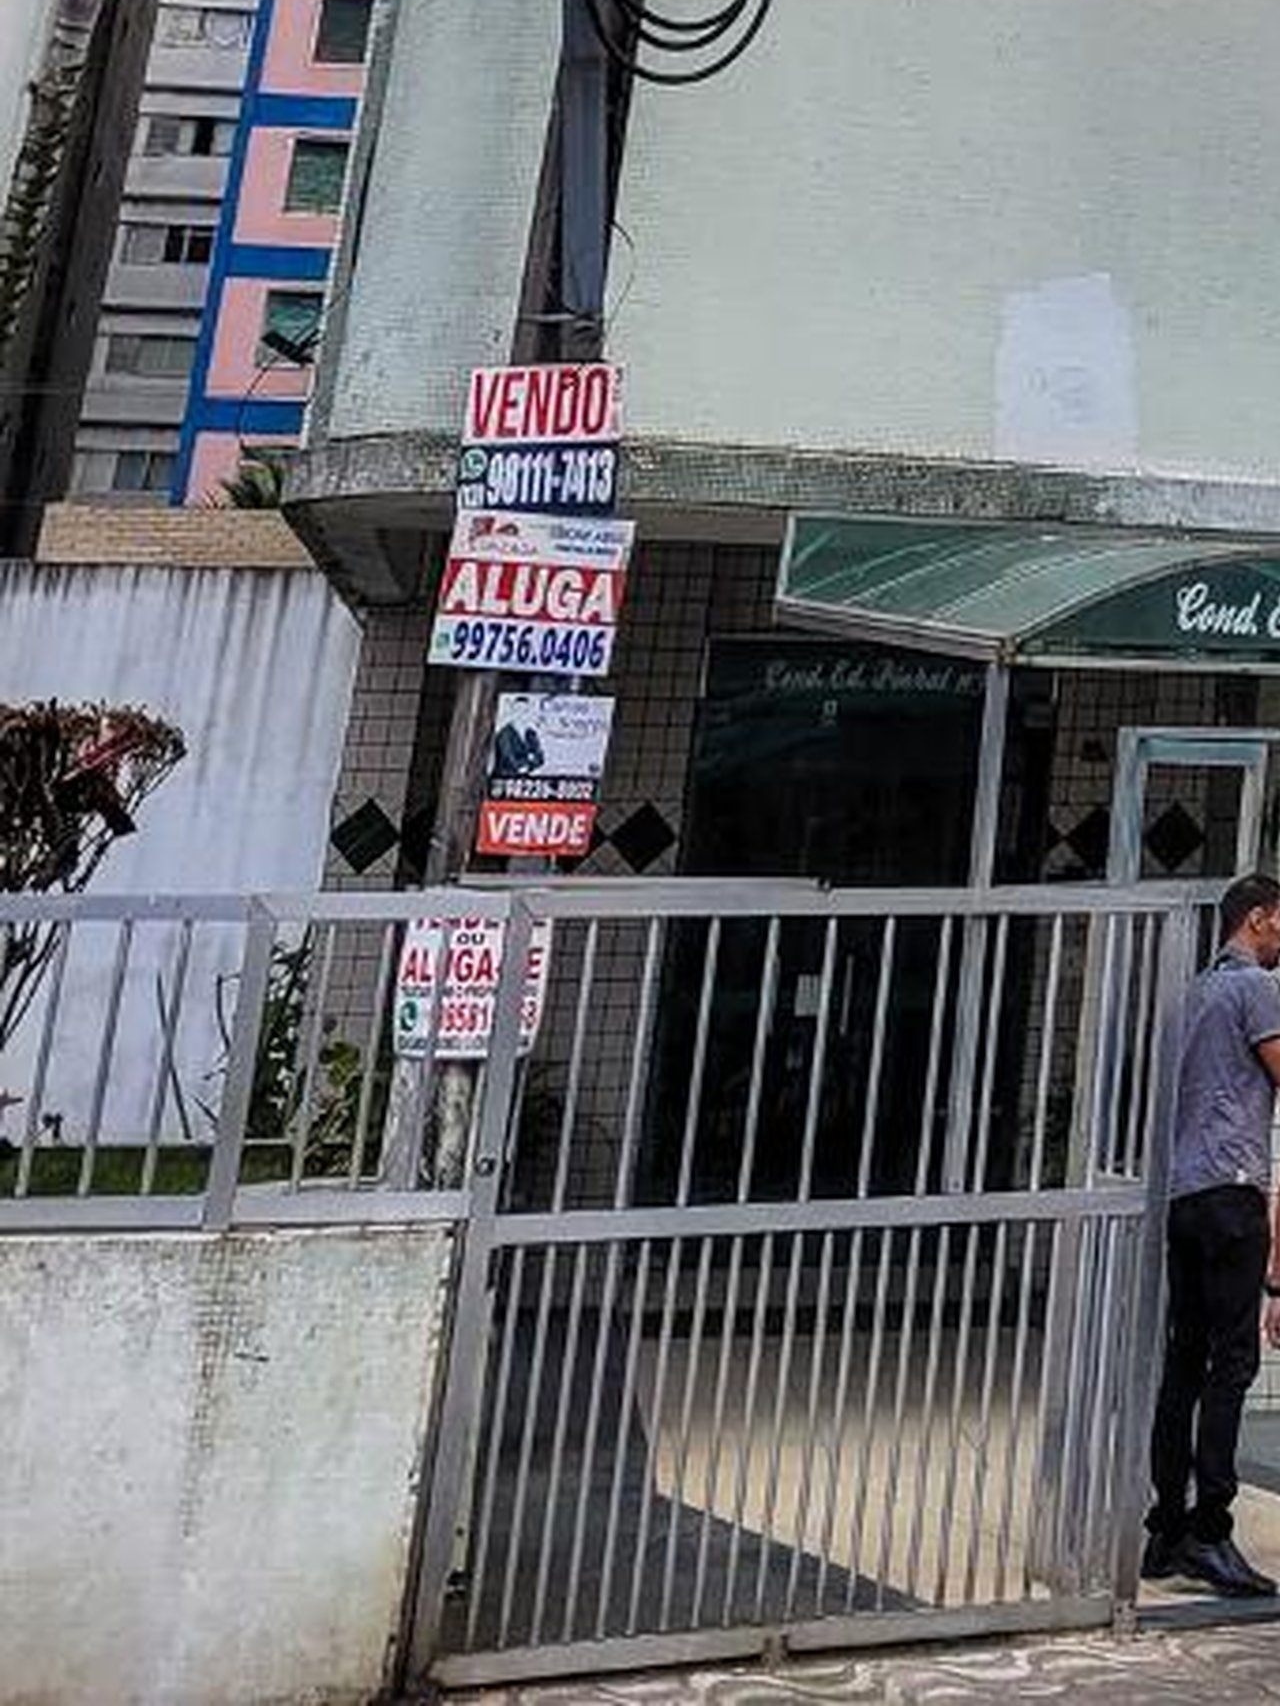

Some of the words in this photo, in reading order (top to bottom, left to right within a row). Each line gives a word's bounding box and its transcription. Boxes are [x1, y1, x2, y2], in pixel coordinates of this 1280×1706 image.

[473, 367, 609, 437] VENDO
[445, 561, 614, 621] ALUGA
[1177, 584, 1257, 635] Cond.
[452, 621, 605, 669] 99756.0406
[487, 812, 586, 844] VENDE
